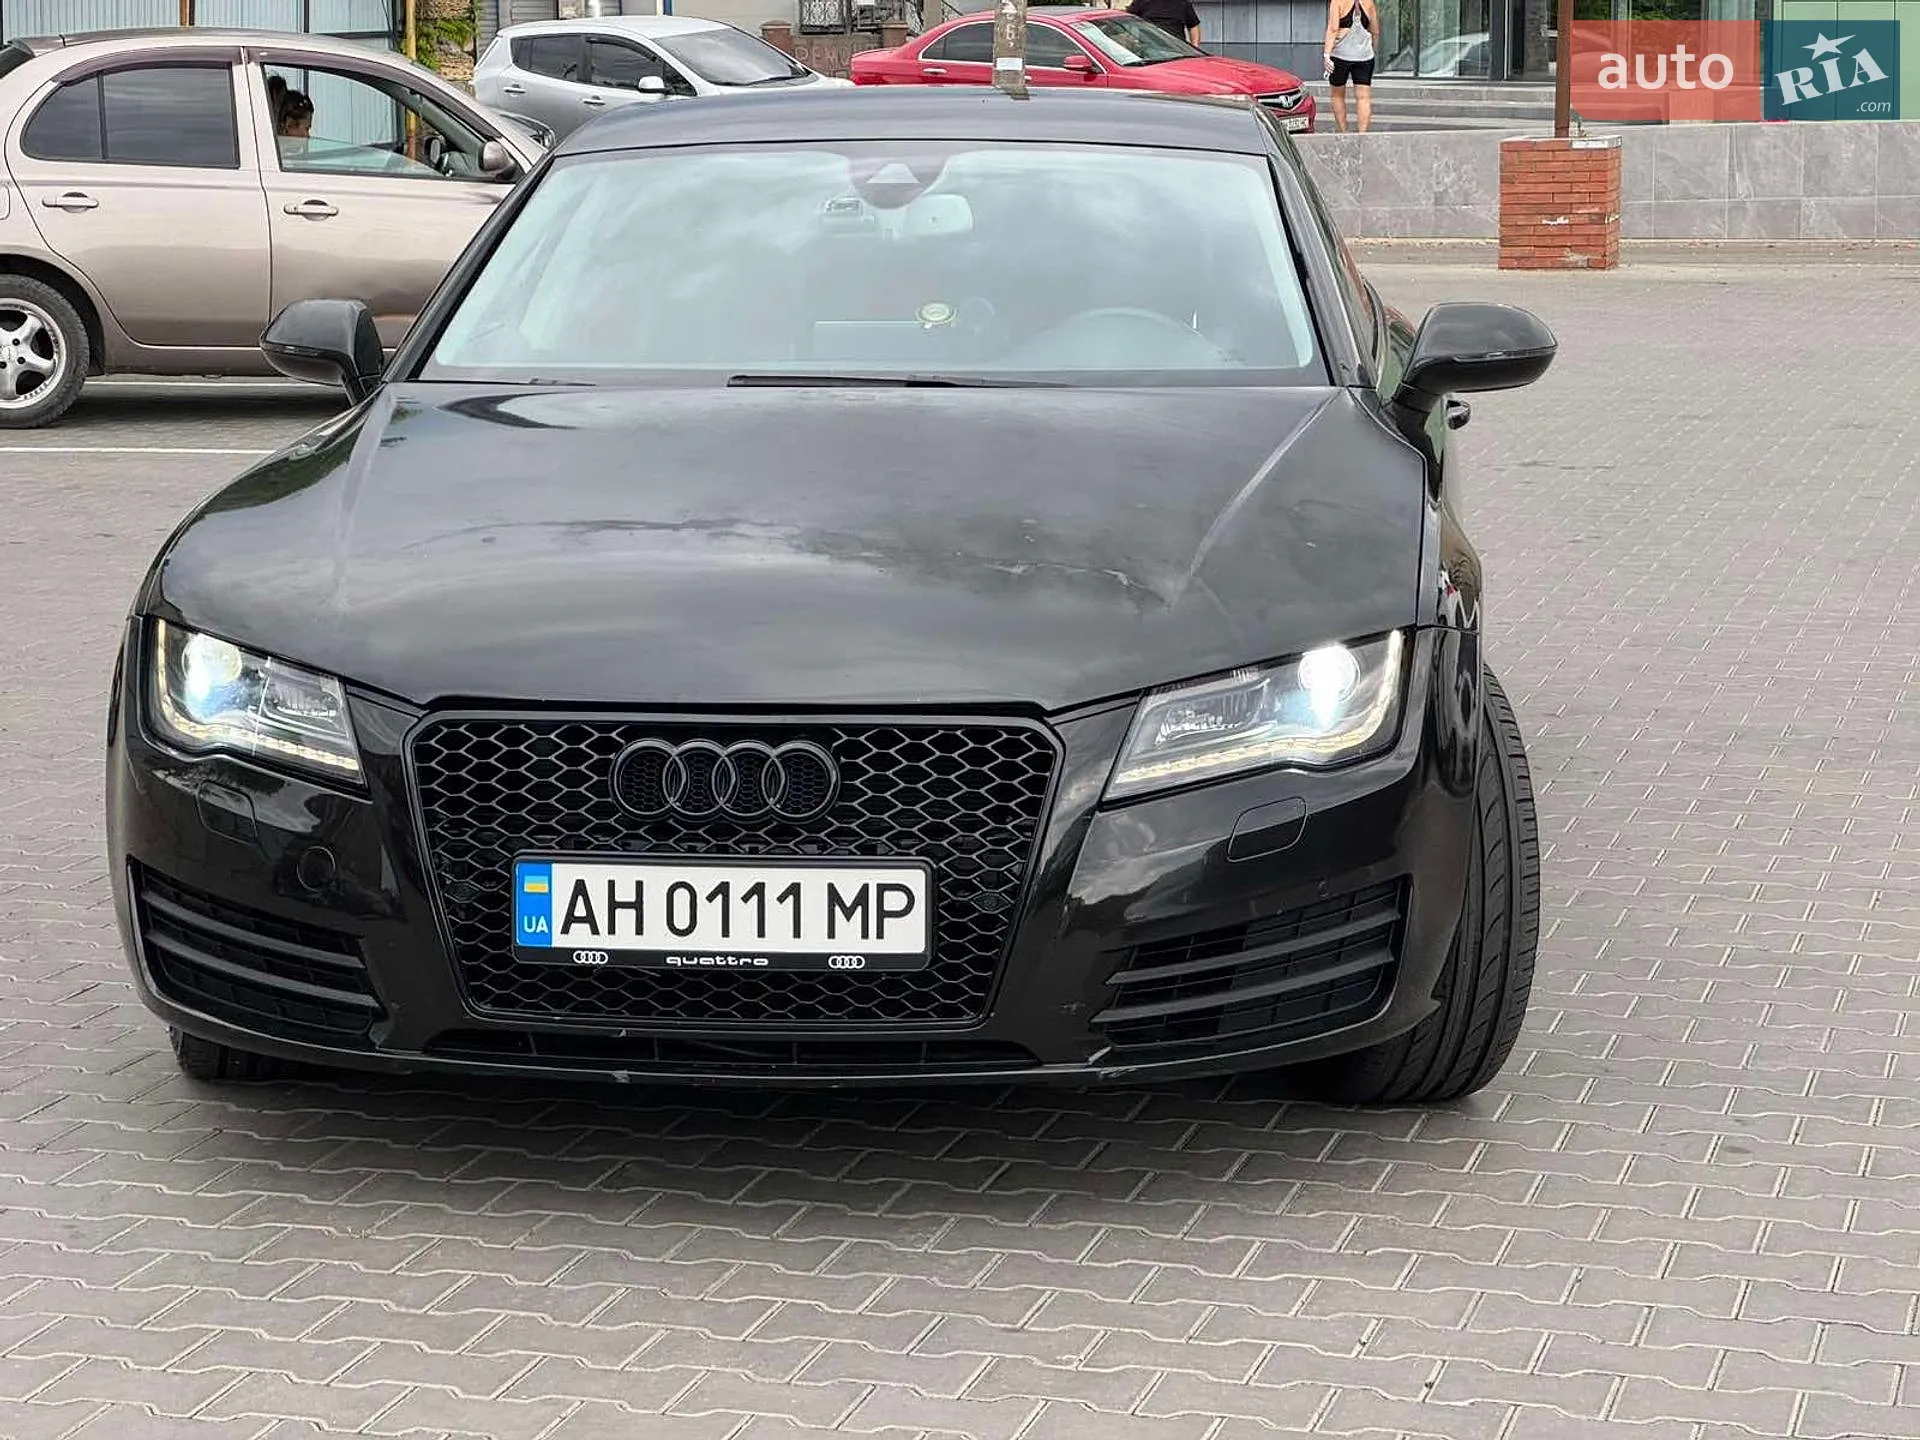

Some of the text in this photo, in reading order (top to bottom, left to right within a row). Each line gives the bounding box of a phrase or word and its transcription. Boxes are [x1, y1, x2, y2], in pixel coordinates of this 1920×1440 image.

[560, 879, 916, 940] AH 0111 MP
[524, 916, 548, 933] UA
[666, 955, 769, 966] quattro
